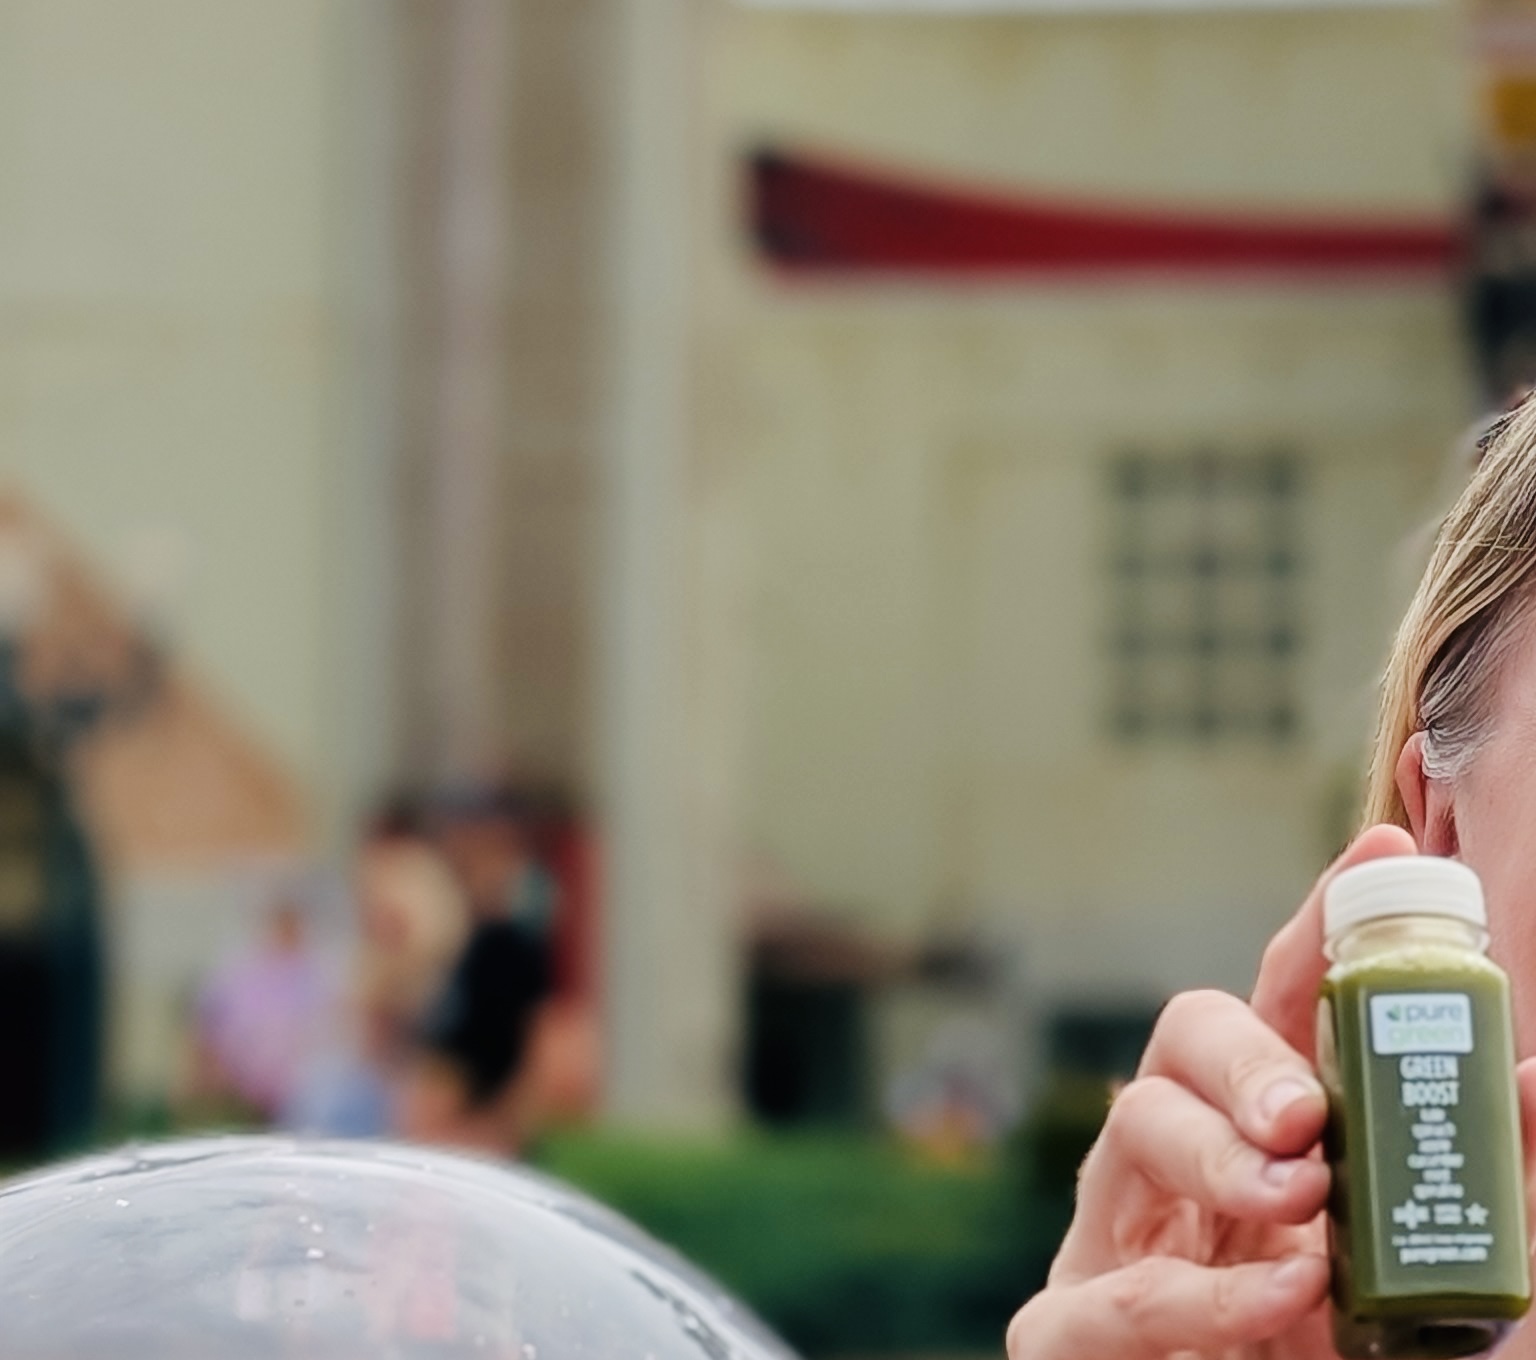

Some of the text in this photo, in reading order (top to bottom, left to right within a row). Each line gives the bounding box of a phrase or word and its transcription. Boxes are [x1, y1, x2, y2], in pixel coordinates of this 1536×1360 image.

[1406, 1004, 1462, 1023] pure
[1400, 1055, 1459, 1080] GREEN
[1402, 1081, 1459, 1107] BOOST
